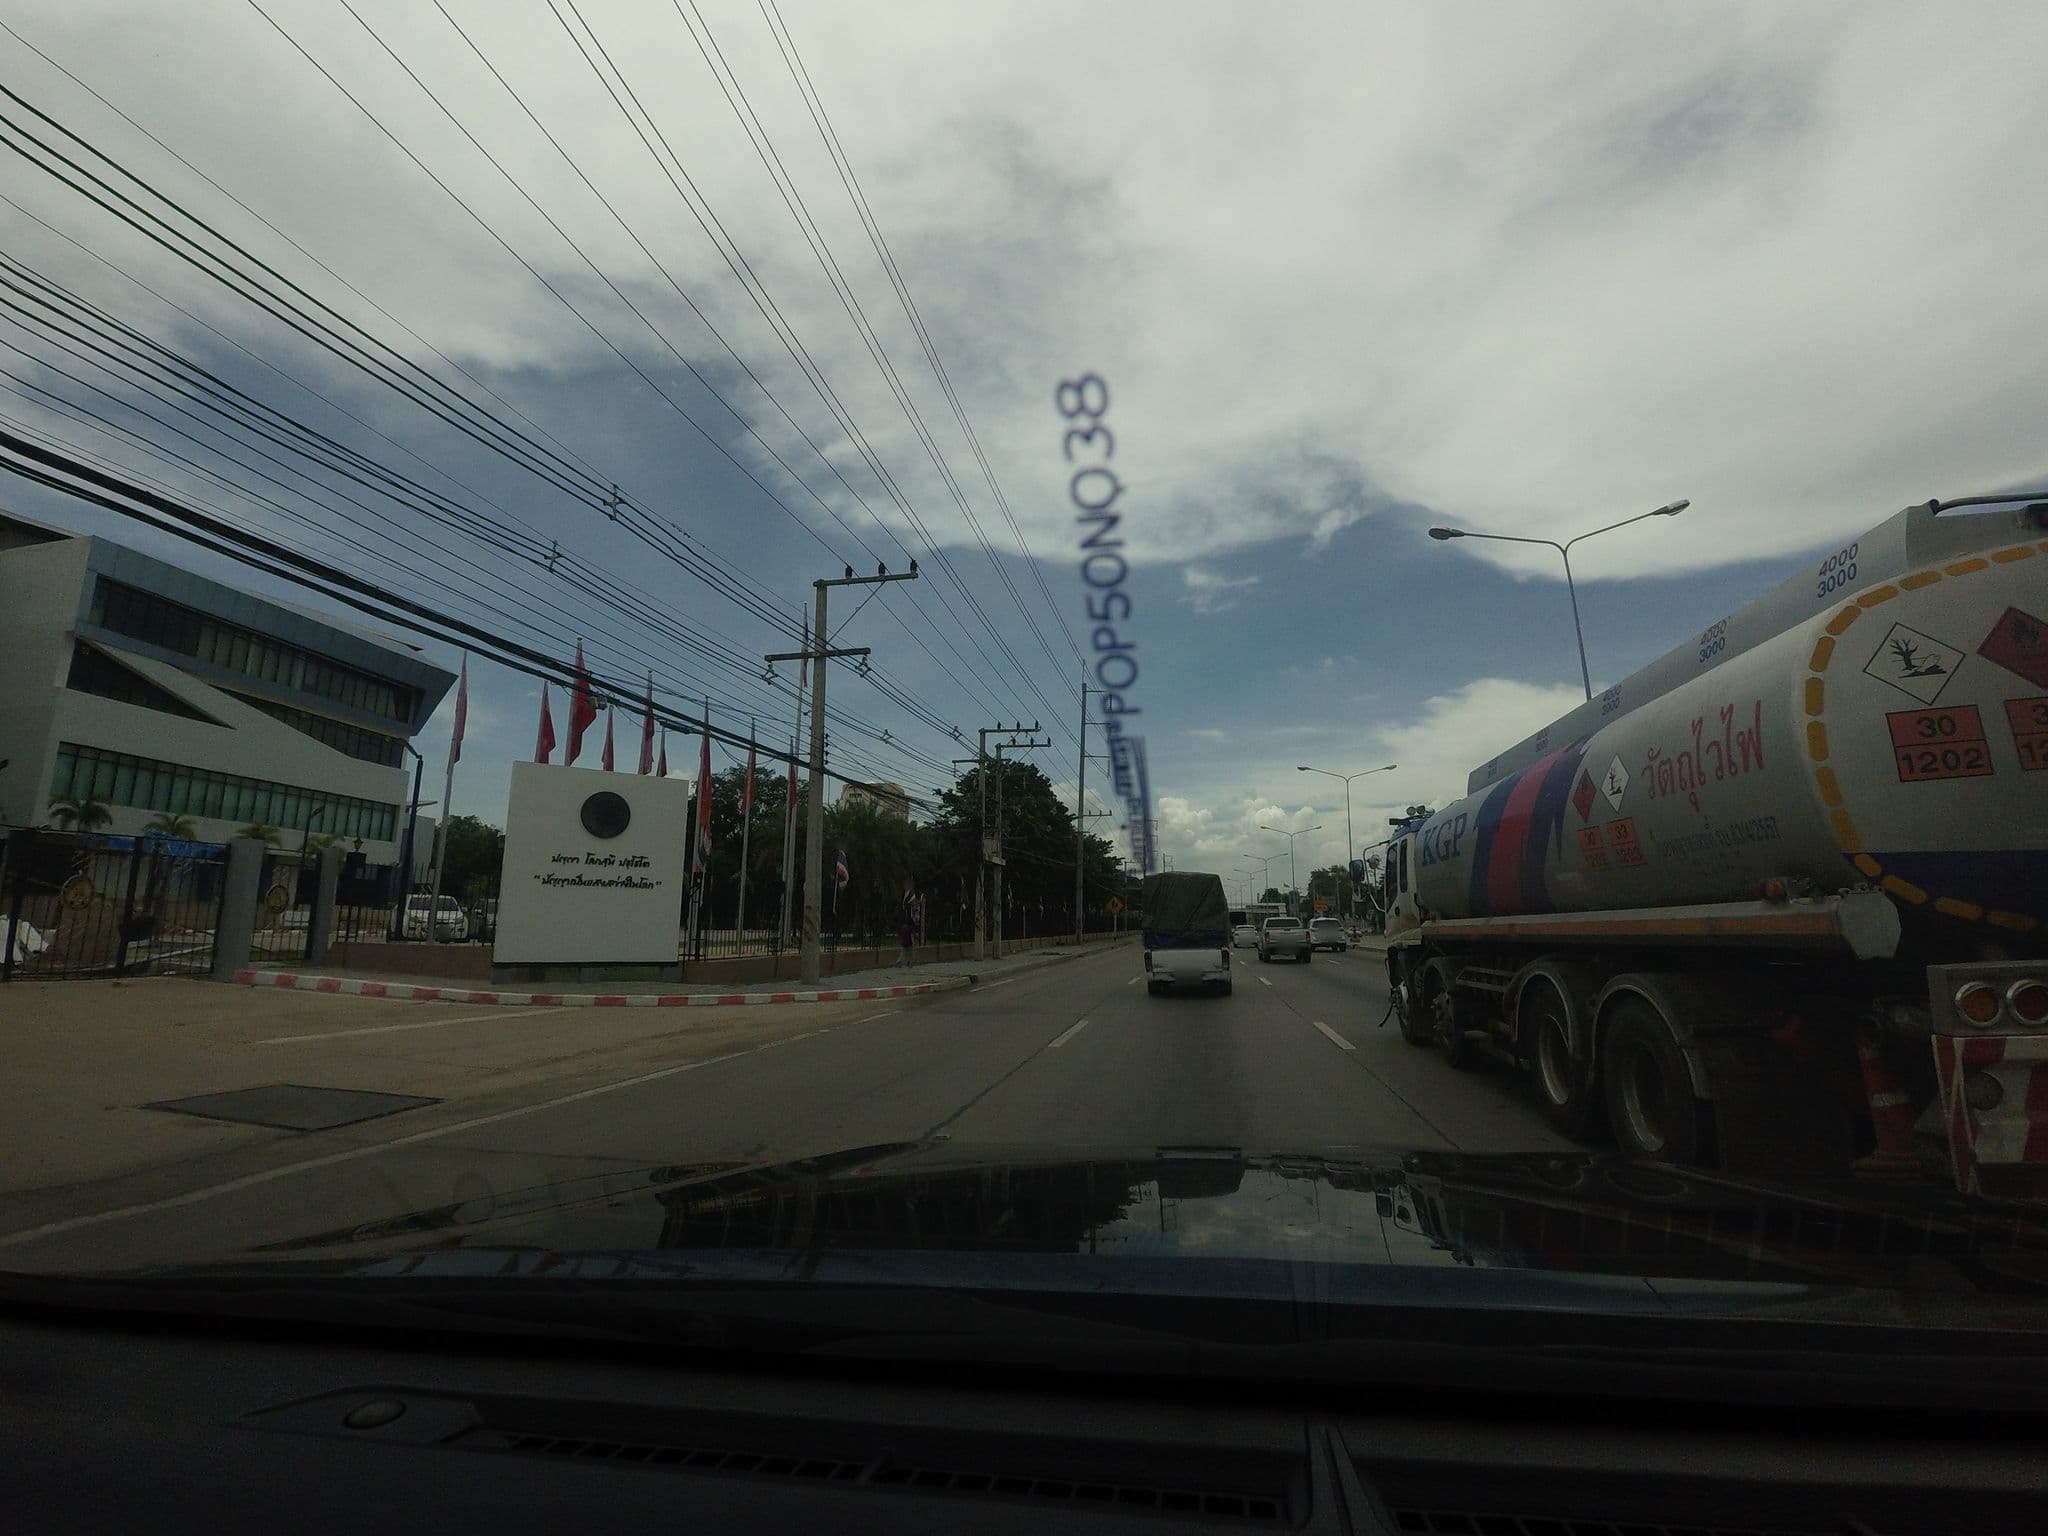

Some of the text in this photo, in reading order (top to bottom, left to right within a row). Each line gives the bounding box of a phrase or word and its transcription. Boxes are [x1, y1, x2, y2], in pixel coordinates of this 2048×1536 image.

[1818, 543, 1858, 577] 4000
[1817, 563, 1857, 598] 3000
[1700, 619, 1728, 646] 4000
[1699, 637, 1726, 663] 3000
[1917, 714, 1956, 738] 30
[1641, 700, 1764, 812] วัตถุไวไฟ
[1901, 747, 1984, 774] 1202
[1422, 810, 1468, 866] KGP
